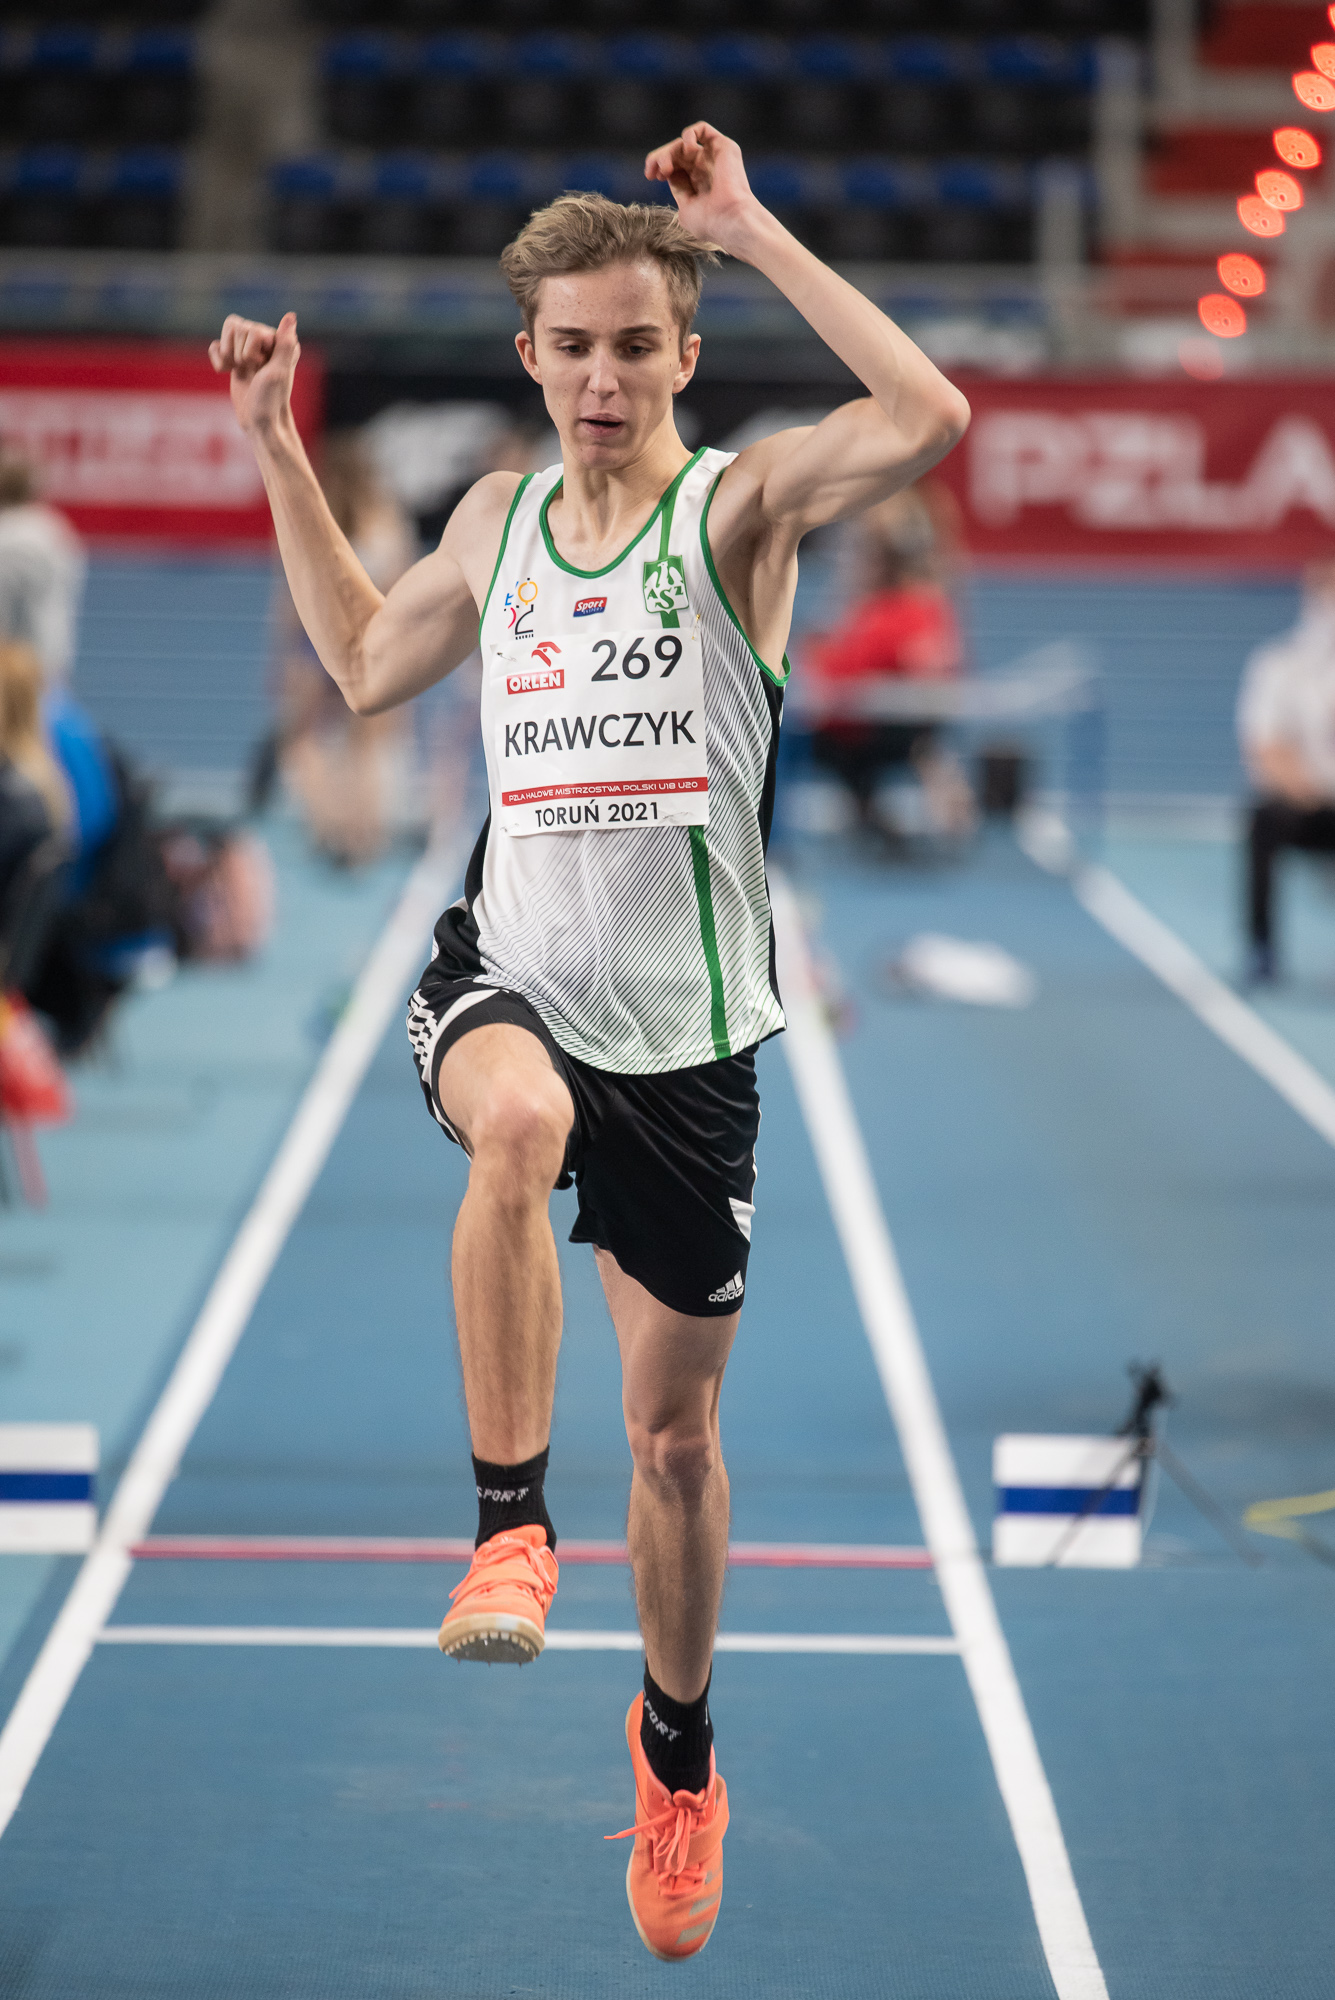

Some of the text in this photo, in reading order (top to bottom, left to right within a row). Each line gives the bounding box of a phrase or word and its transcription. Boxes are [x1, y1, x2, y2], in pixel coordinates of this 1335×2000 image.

[576, 599, 604, 612] Sport
[590, 634, 683, 682] 269
[509, 671, 561, 692] ORLEN
[504, 709, 697, 758] KRAWCZYK
[508, 781, 699, 802] PZLA HALOWE MISTRZOSTWA POLSKI U18 U20
[535, 798, 658, 828] TORUŃ 2021
